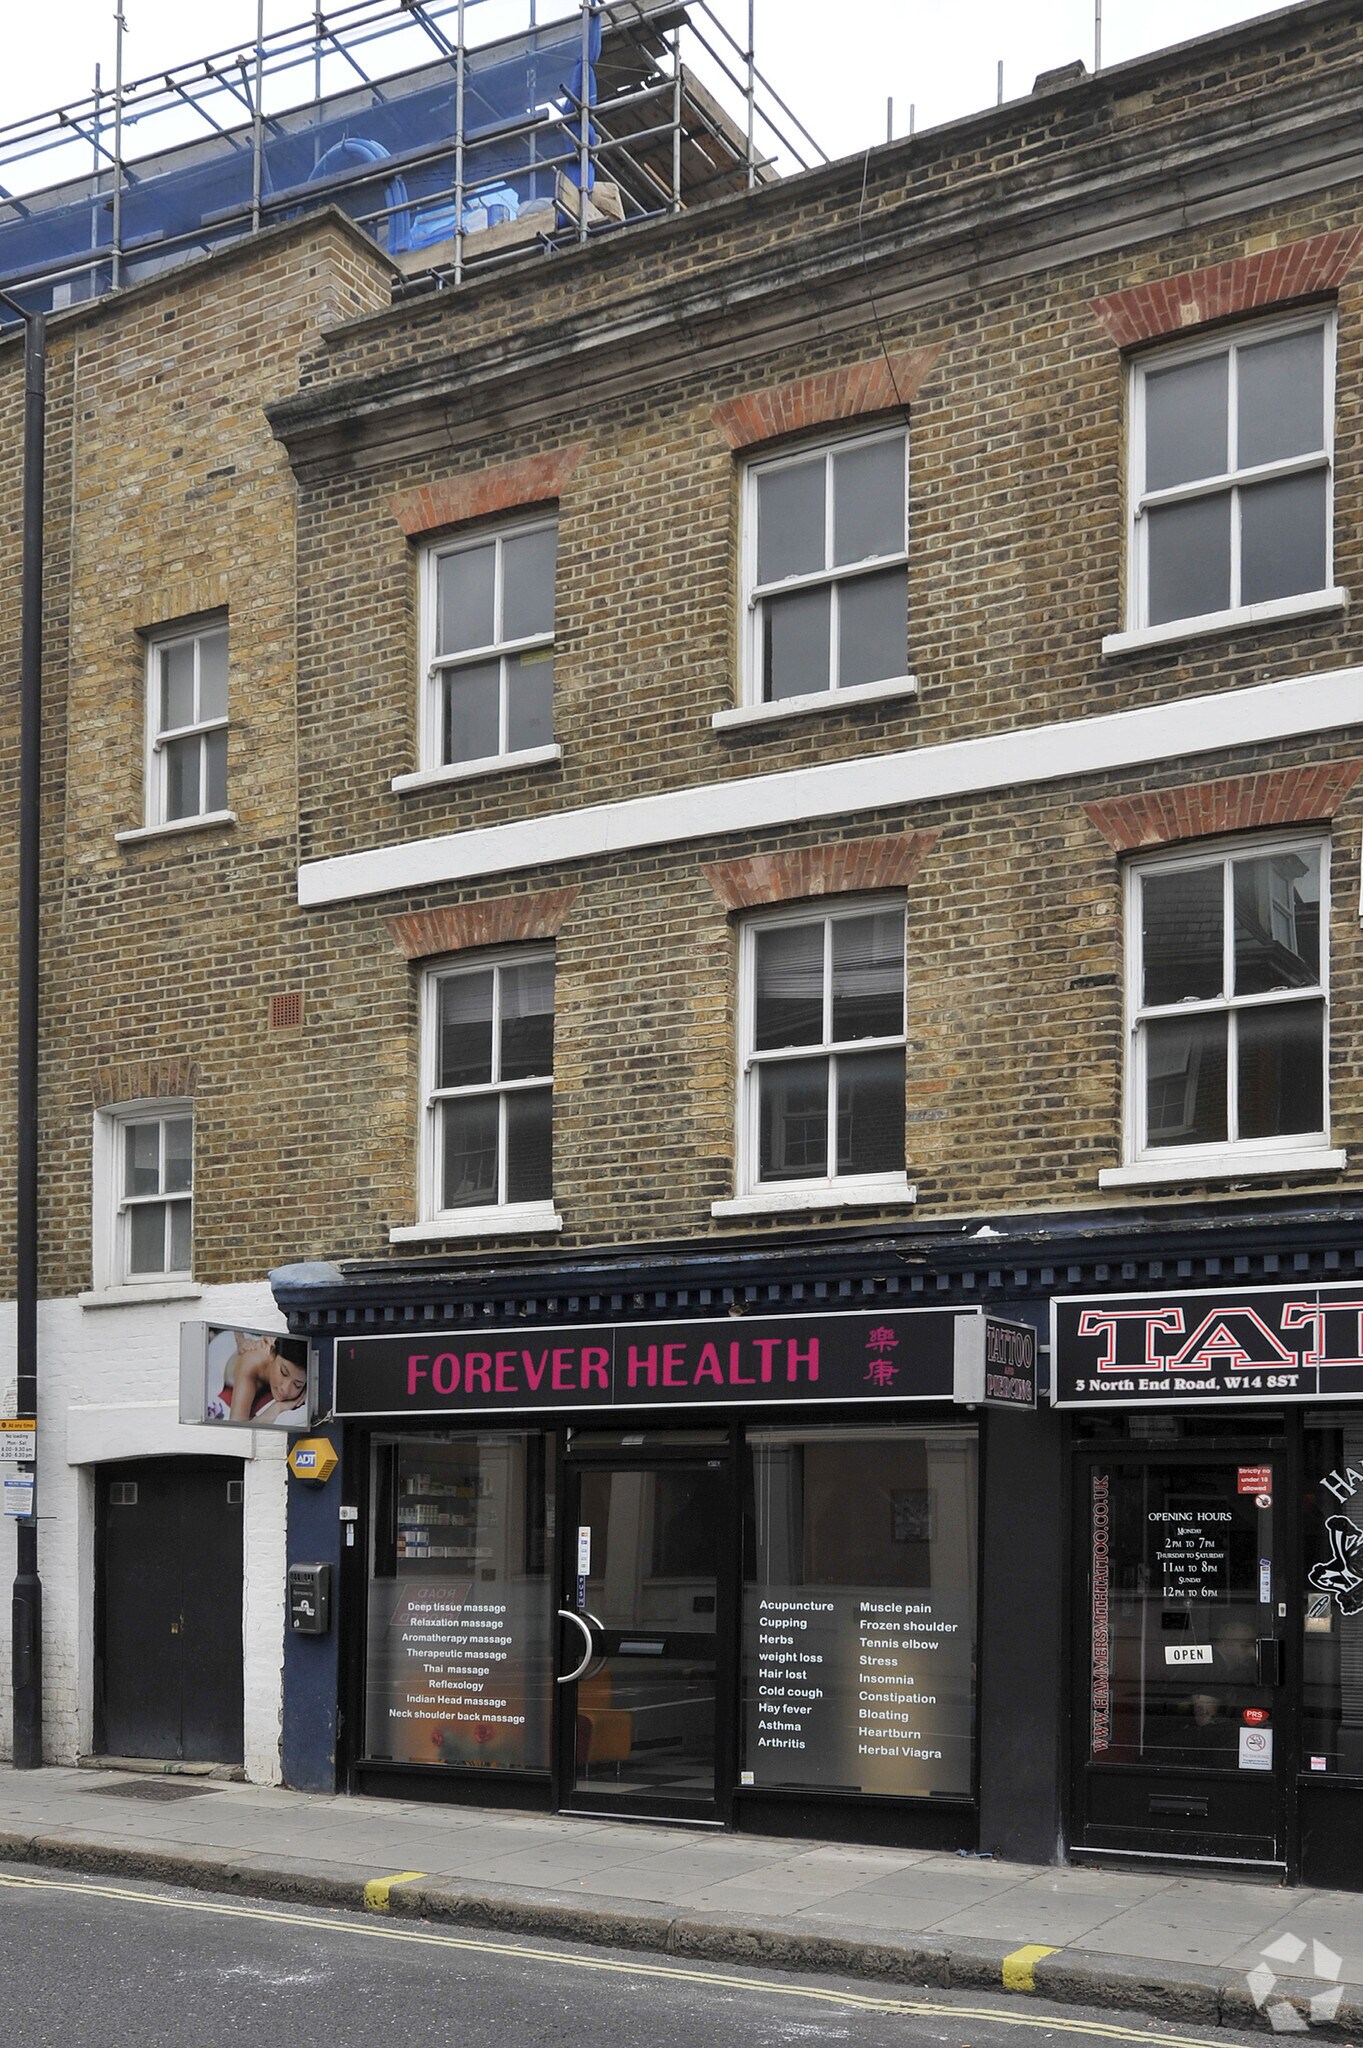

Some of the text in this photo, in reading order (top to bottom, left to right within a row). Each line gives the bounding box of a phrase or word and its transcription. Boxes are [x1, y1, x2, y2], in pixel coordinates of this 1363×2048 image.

[987, 1325, 1033, 1368] TATTOO
[407, 1337, 819, 1395] FOREVER HEALTH
[987, 1374, 1032, 1400] PIERCING
[1076, 1375, 1299, 1391] 3 North End Road, W14 8ST
[296, 1454, 316, 1466] ADT
[1320, 1461, 1363, 1504] HA
[1148, 1512, 1232, 1521] OPENING HOURS
[408, 1603, 432, 1612] Deep
[434, 1603, 462, 1611] tissue
[464, 1604, 506, 1614] massage
[760, 1600, 834, 1611] Acupuncture
[860, 1602, 931, 1615] Muscle pain
[1093, 1475, 1109, 1753] WWW.HAMMERSMITHTATTOO.CO.UK
[410, 1618, 503, 1629] Relaxation massage
[760, 1617, 807, 1630] Cupping
[860, 1620, 958, 1632] Frozen shoulder
[402, 1633, 512, 1645] Aromatherapy massage
[760, 1634, 794, 1645] Herbs
[860, 1638, 938, 1650] Tennis elbow
[406, 1648, 507, 1661] Therapeutic massage
[759, 1652, 823, 1663] weight loss
[859, 1655, 898, 1666] Stress
[1174, 1649, 1203, 1660] OPEN
[423, 1664, 489, 1676] Thai massage
[759, 1669, 807, 1679] Hair lost
[859, 1673, 914, 1684] Insomnia
[429, 1680, 483, 1691] Reflexology
[759, 1686, 823, 1699] Cold cough
[859, 1691, 936, 1704] Constipation
[407, 1694, 506, 1708] Indian Head massage
[759, 1703, 812, 1715] Hay fever
[389, 1708, 525, 1724] Neck shoulder back massage
[859, 1709, 909, 1722] Bloating
[758, 1720, 801, 1731] Asthma
[859, 1727, 921, 1739] Heartburn
[758, 1737, 805, 1749] Arthritis
[858, 1745, 942, 1760] Herbal Viagra
